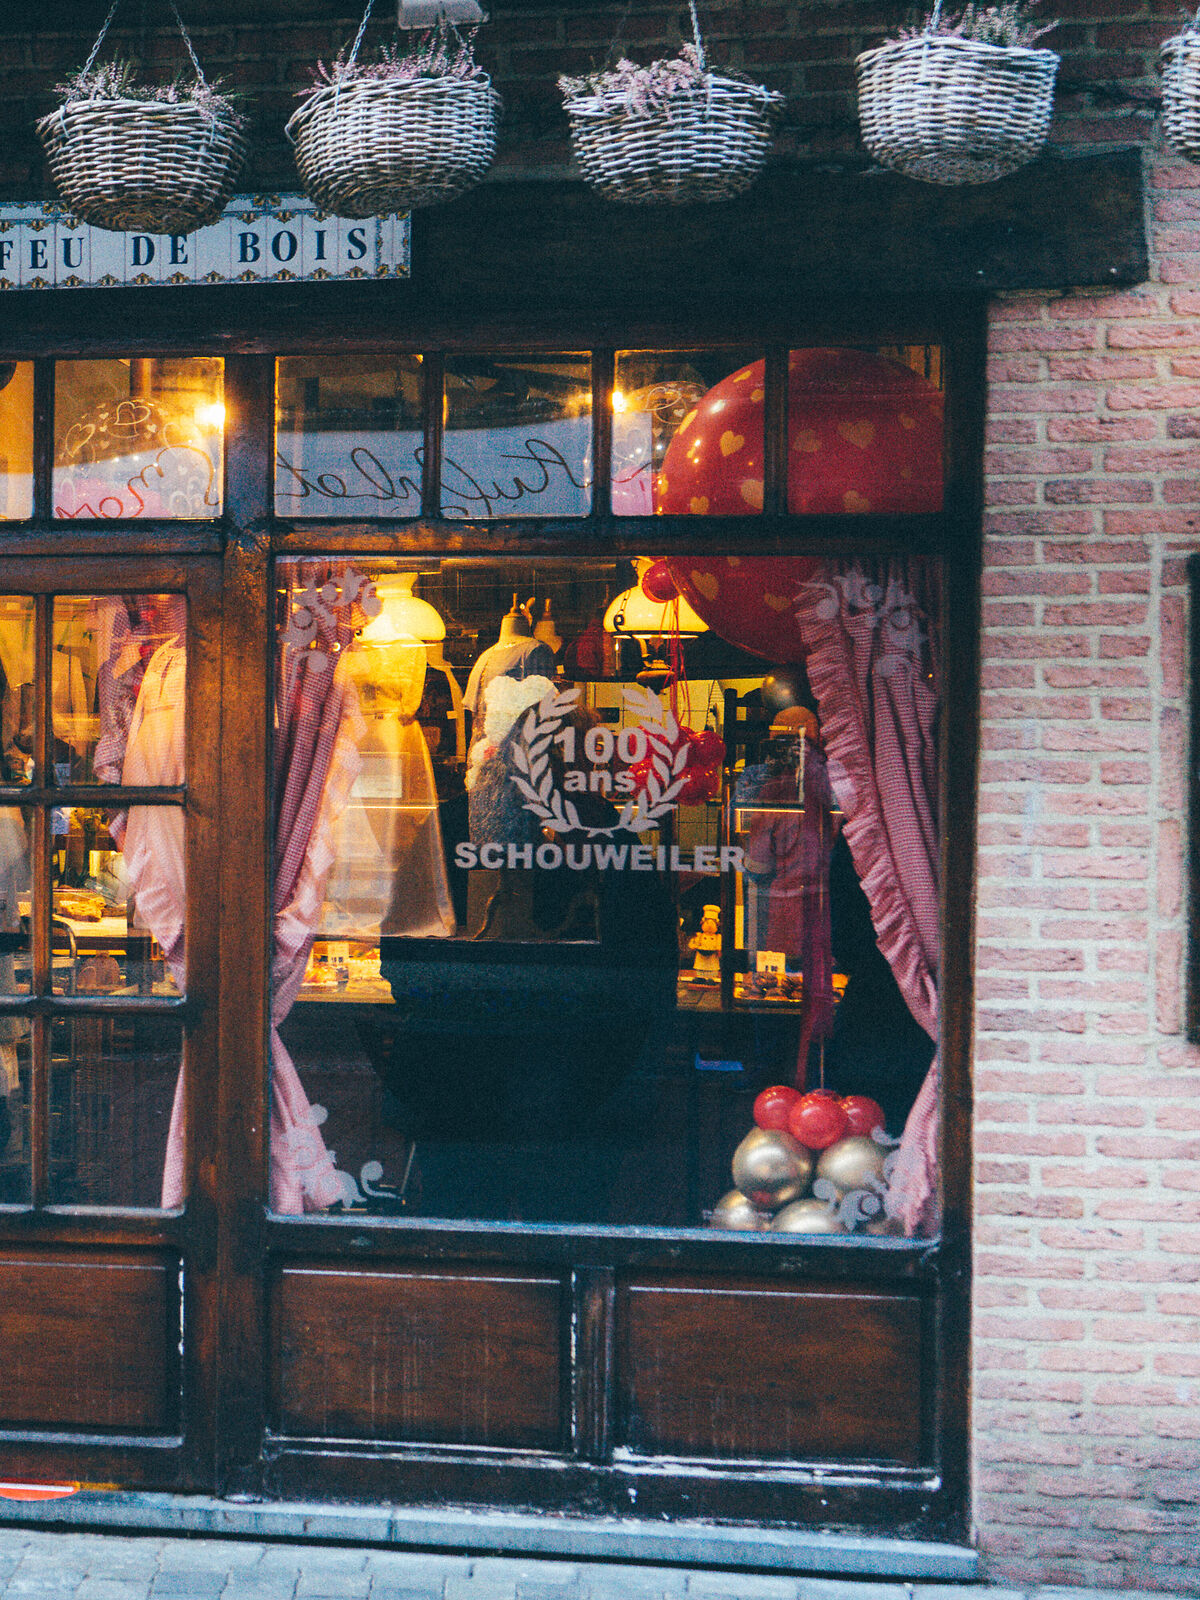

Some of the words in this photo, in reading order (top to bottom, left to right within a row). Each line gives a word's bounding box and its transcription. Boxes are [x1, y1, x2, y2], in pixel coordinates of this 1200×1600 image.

[131, 234, 190, 266] DE
[237, 226, 369, 264] BOIS
[553, 726, 648, 764] 100
[563, 768, 637, 793] ans
[454, 841, 748, 873] SCHOUWEILER
